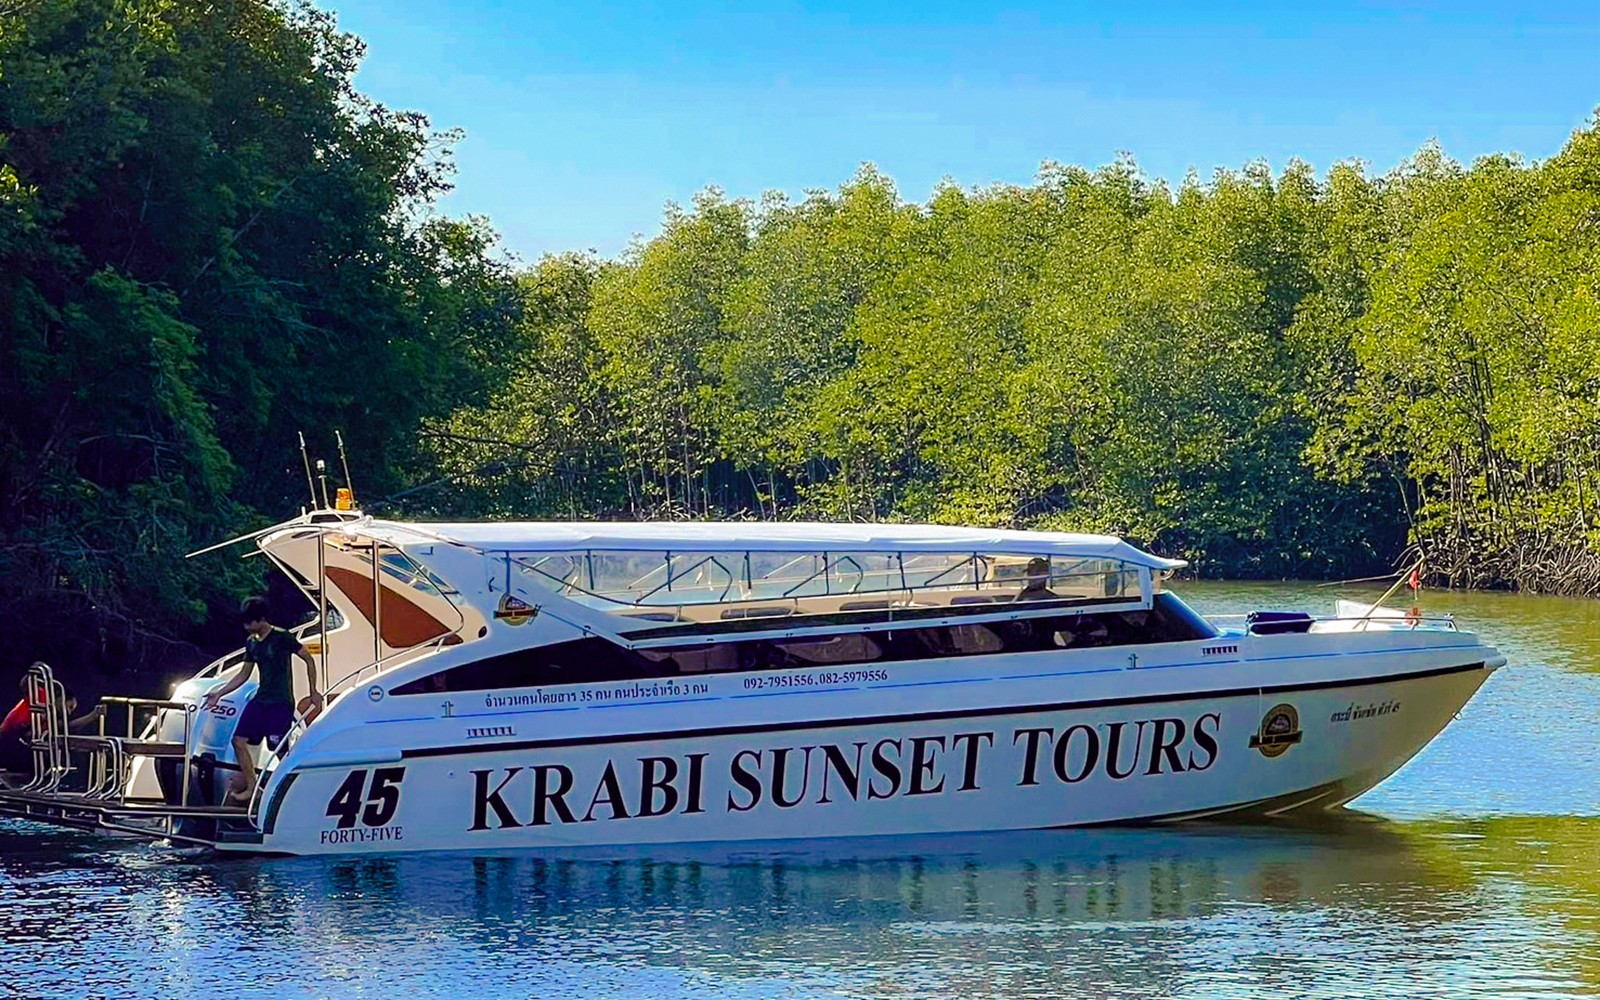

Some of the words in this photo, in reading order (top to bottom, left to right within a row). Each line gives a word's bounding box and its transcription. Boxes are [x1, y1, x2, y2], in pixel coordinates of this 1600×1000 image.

[580, 690, 593, 702] 35
[595, 690, 612, 701] คน
[614, 680, 680, 699] คนประจำเรือ
[683, 684, 690, 696] 3
[692, 684, 708, 695] คน
[210, 705, 237, 717] 250
[466, 753, 710, 832] KRABI
[727, 731, 994, 813] SUNSET
[1012, 712, 1222, 787] TOURS
[325, 766, 406, 830] 45
[320, 826, 403, 845] FORTY-FIVE
